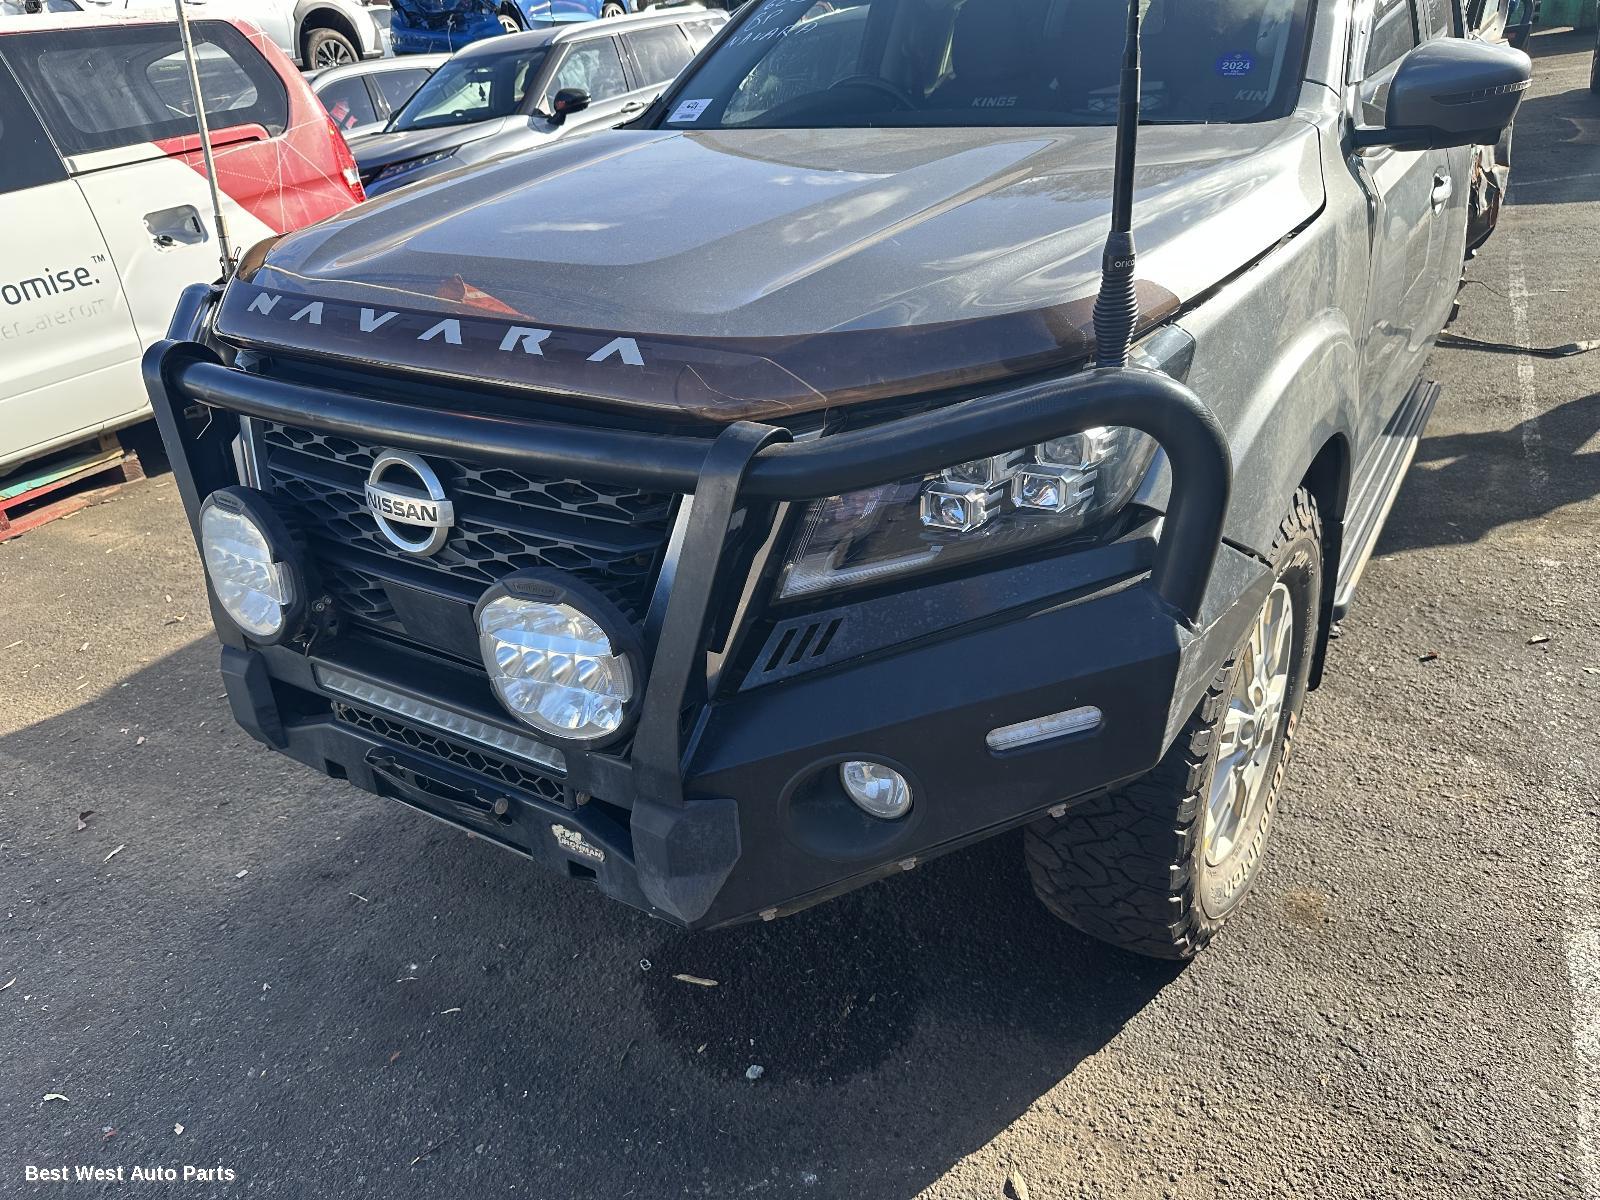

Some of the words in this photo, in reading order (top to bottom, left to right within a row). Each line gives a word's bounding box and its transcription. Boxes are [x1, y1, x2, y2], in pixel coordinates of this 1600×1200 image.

[1222, 62, 1250, 70] 2024
[971, 96, 1018, 107] KINGS
[246, 292, 646, 366] NAVARA
[367, 491, 438, 523] NISSAN
[1223, 710, 1297, 898] BFGoodrich
